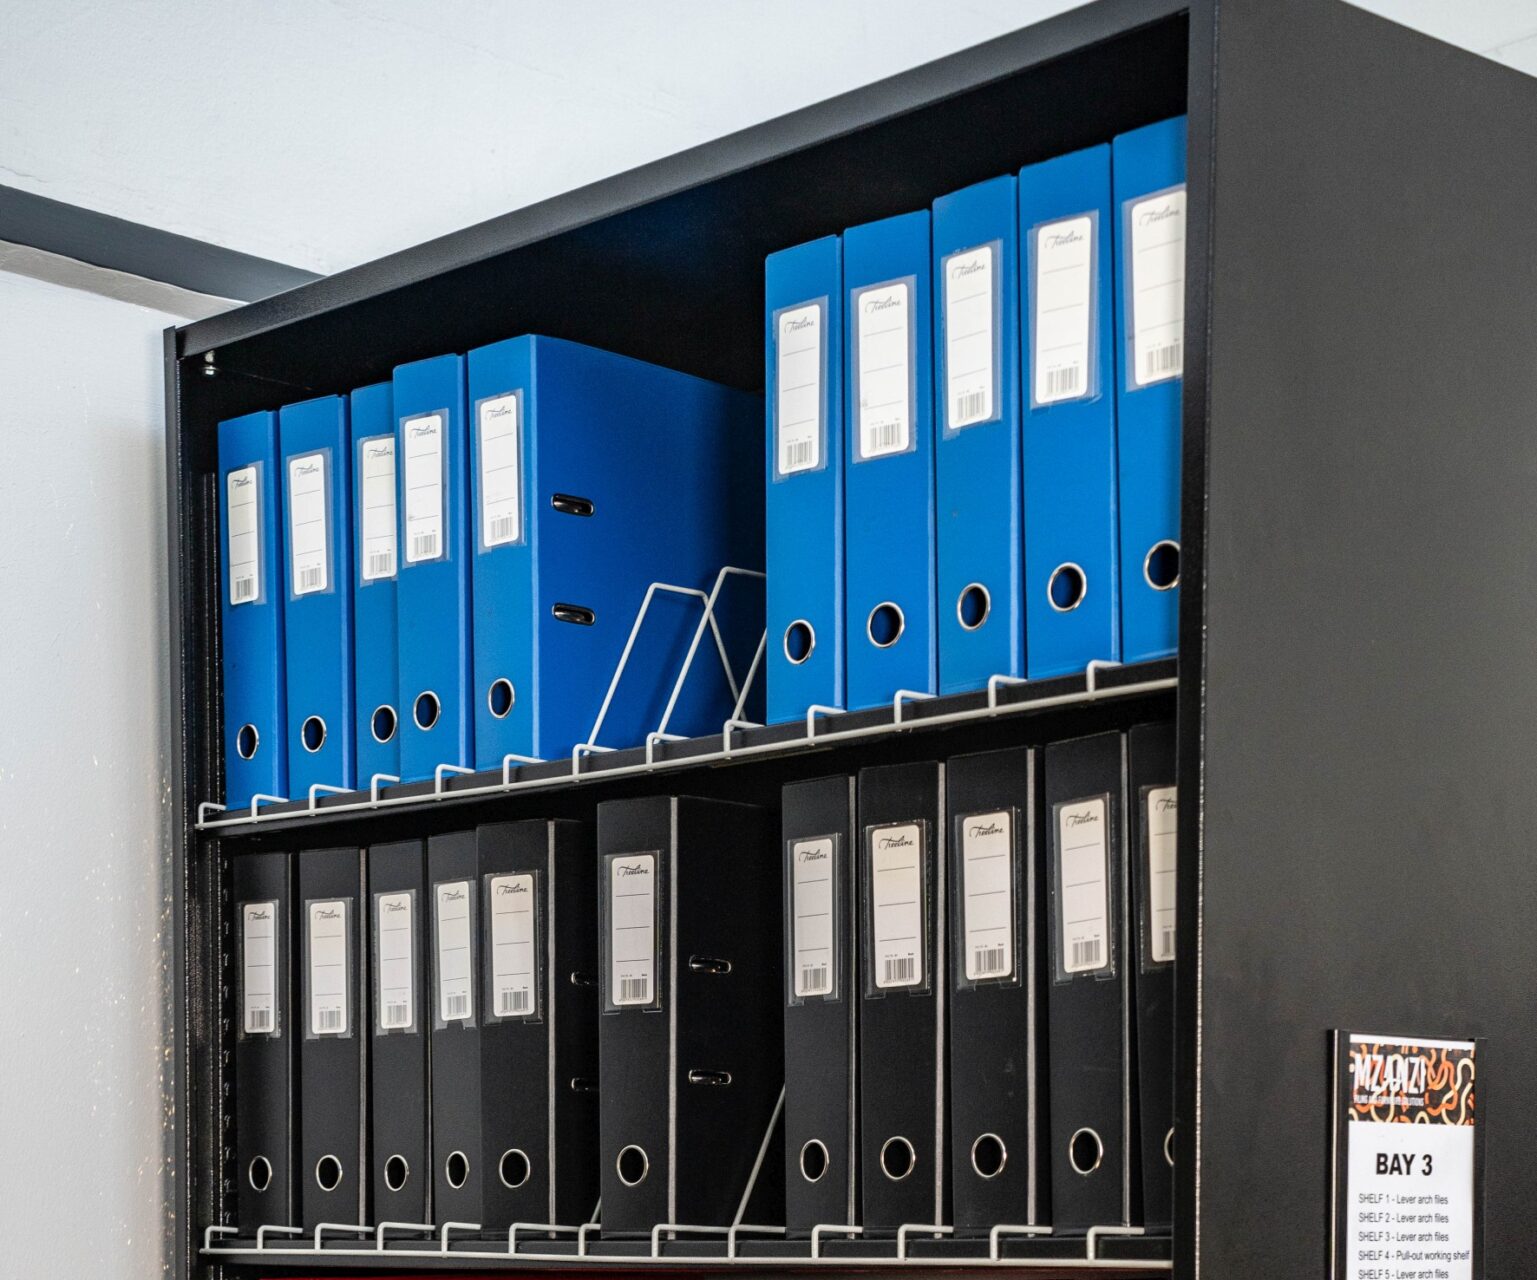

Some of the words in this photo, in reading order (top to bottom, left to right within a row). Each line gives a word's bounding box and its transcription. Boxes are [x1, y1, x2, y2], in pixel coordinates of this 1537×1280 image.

[1139, 204, 1181, 226] Treeline
[1044, 229, 1084, 249] Treeline
[950, 259, 986, 281] Treeline
[864, 295, 901, 314] Treeline
[783, 316, 815, 335] Treeline
[1065, 810, 1099, 828] Treeline
[968, 822, 1004, 838] Treeline
[878, 834, 914, 850] Treeline
[798, 848, 828, 864] Treeline
[616, 863, 650, 878] Treeline
[441, 889, 466, 903] Treeline
[496, 882, 529, 896] Treeline
[384, 901, 408, 912] Treeline
[247, 909, 271, 921] Treeline
[314, 908, 341, 921] Treeline
[1353, 1053, 1426, 1094] MZANZI
[1376, 1153, 1416, 1175] BAY
[1421, 1154, 1433, 1176] 3
[1358, 1193, 1383, 1204] SHELF
[1396, 1194, 1417, 1204] Lever
[1418, 1194, 1434, 1204] arch
[1434, 1194, 1449, 1204] files
[1358, 1212, 1383, 1223] SHELF
[1396, 1213, 1417, 1223] Lever
[1418, 1213, 1434, 1223] arch
[1434, 1213, 1449, 1223] files
[1358, 1230, 1383, 1241] SHELF
[1396, 1231, 1417, 1241] Lever
[1418, 1231, 1434, 1241] arch
[1434, 1231, 1449, 1241] files
[1358, 1249, 1383, 1260] SHELF
[1396, 1250, 1423, 1261] Pull-out
[1424, 1250, 1452, 1263] working
[1453, 1250, 1470, 1260] shelf
[1358, 1268, 1383, 1279] SHELF
[1396, 1269, 1417, 1279] Lever
[1418, 1269, 1434, 1279] arch
[1434, 1269, 1449, 1279] files
